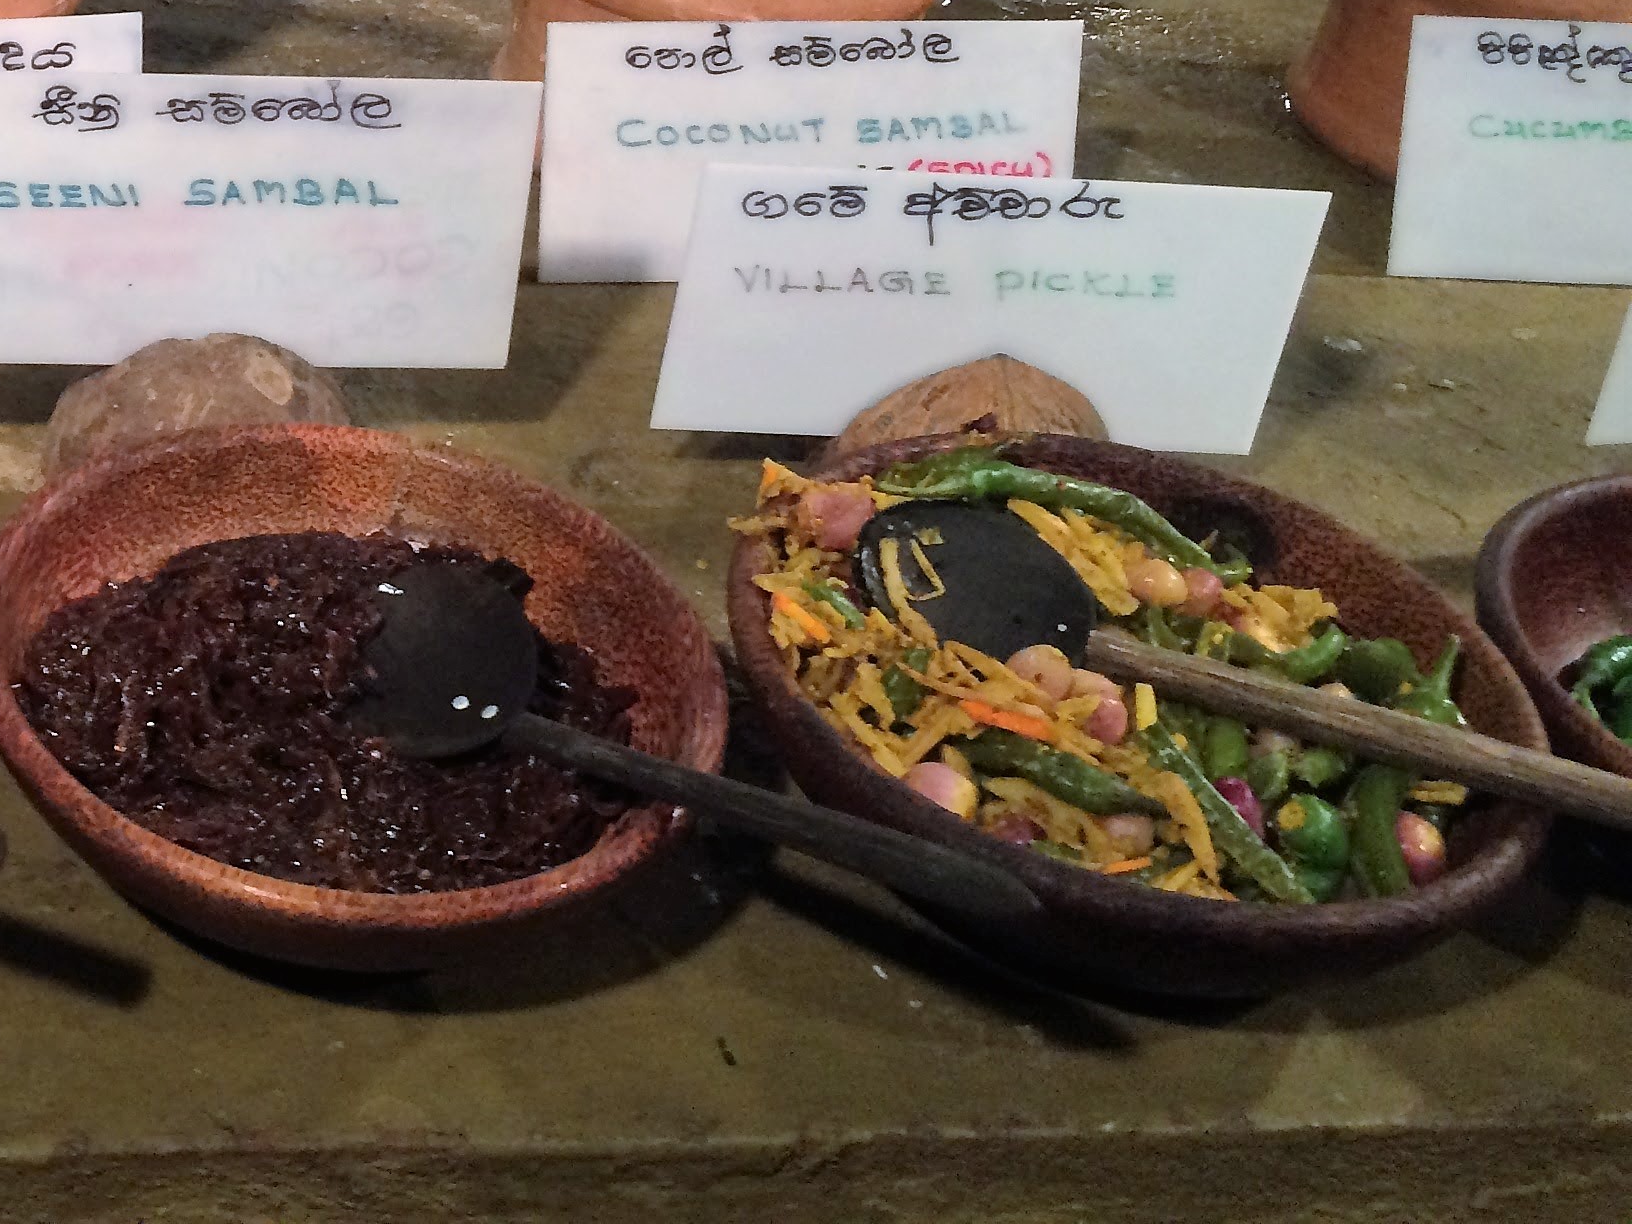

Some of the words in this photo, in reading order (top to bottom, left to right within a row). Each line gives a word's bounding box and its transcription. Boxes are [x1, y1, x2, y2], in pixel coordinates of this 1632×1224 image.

[624, 23, 743, 74] පොල්
[615, 117, 825, 148] COCONUT
[856, 111, 1029, 144] SAMBAL
[183, 177, 399, 208] SAMBAL
[735, 266, 951, 296] VILLAGE
[995, 268, 1179, 301] PICKLE
